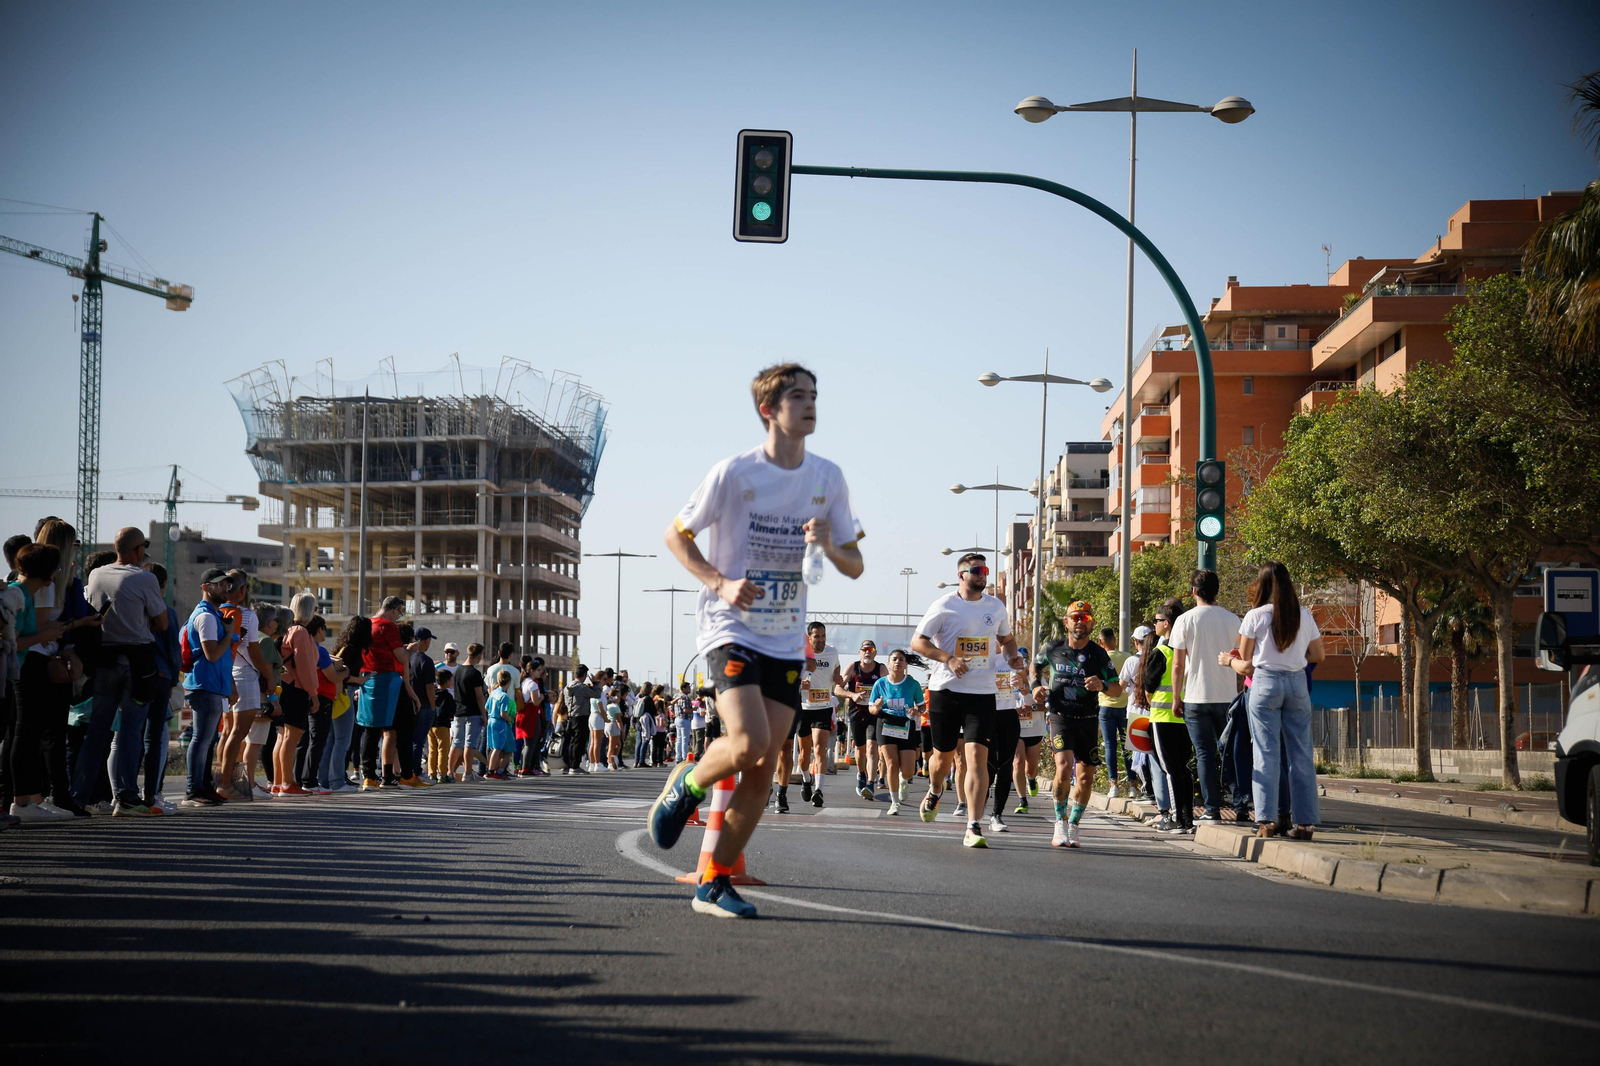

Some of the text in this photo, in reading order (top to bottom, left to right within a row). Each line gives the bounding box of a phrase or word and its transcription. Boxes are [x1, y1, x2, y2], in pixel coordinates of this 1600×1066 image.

[749, 511, 810, 525] Medio Marat
[749, 522, 806, 536] Almería 20
[959, 641, 987, 652] 1954
[815, 659, 830, 668] ike
[1055, 663, 1086, 677] IDESA
[811, 691, 829, 699] 1372
